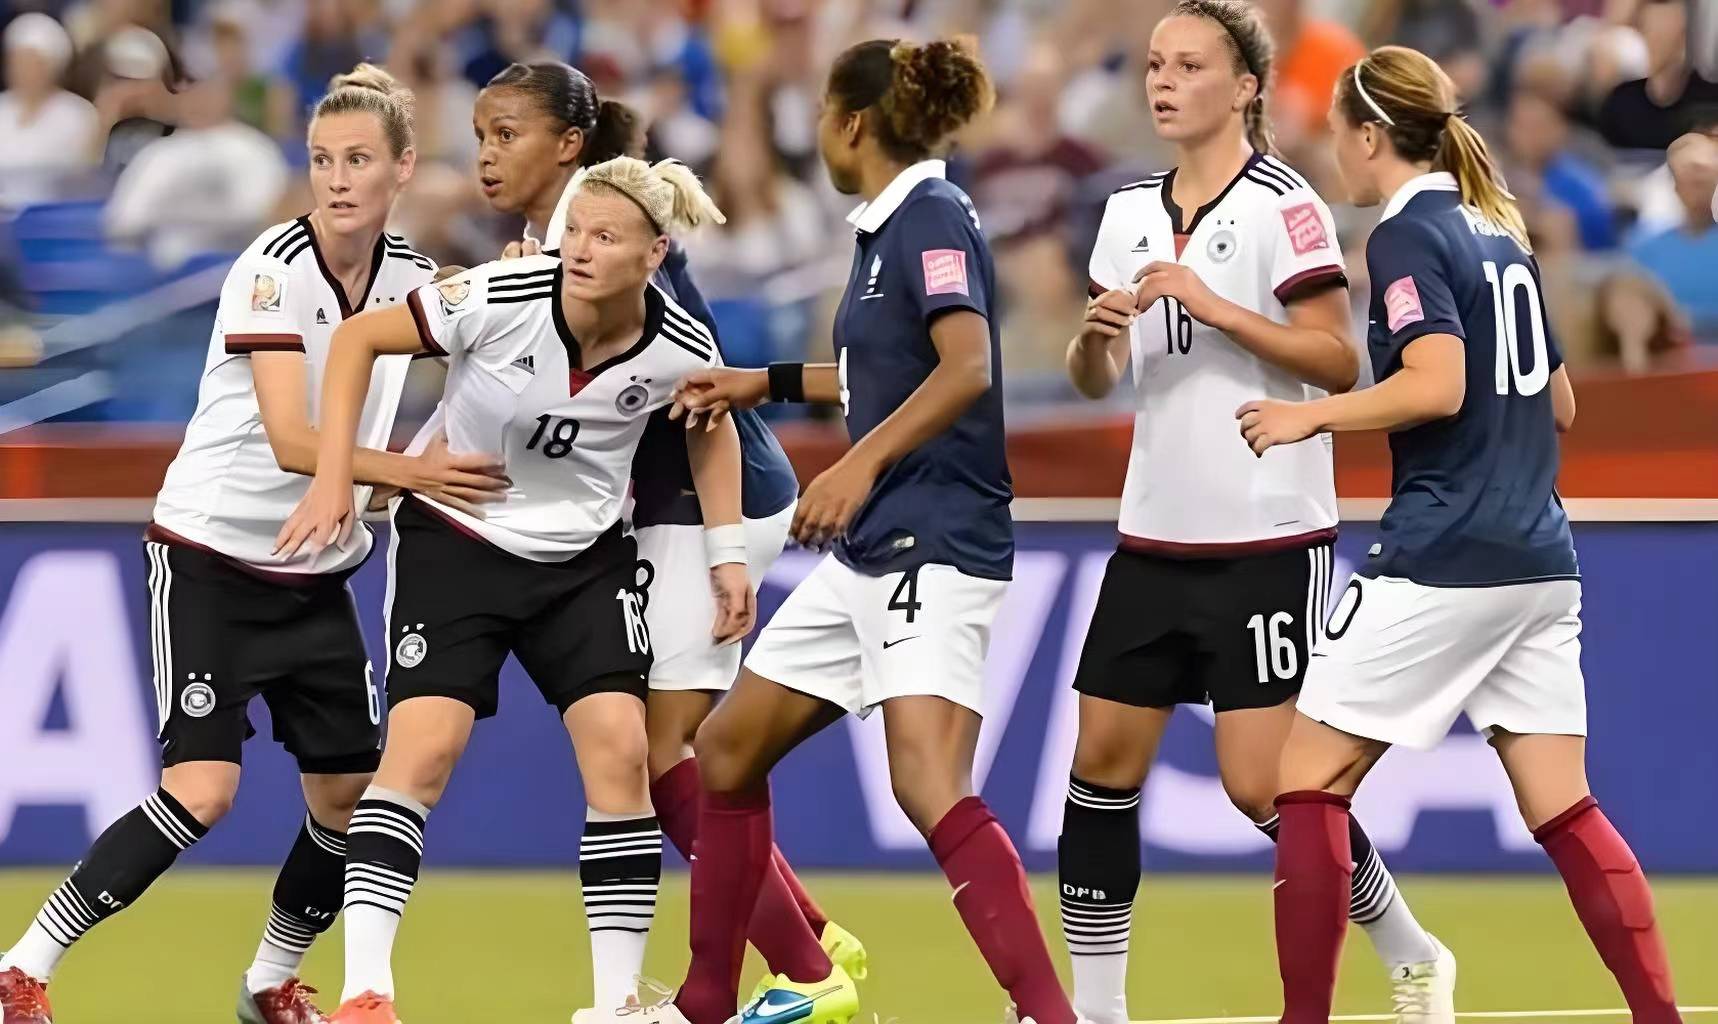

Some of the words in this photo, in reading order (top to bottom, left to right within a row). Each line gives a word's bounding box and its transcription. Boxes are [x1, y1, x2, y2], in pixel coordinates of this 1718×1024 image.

[1163, 296, 1192, 354] 16
[1482, 261, 1550, 396] 10
[526, 413, 580, 459] 18
[616, 588, 649, 655] 18
[887, 566, 922, 623] 4
[1246, 610, 1298, 683] 16
[364, 659, 380, 725] 6
